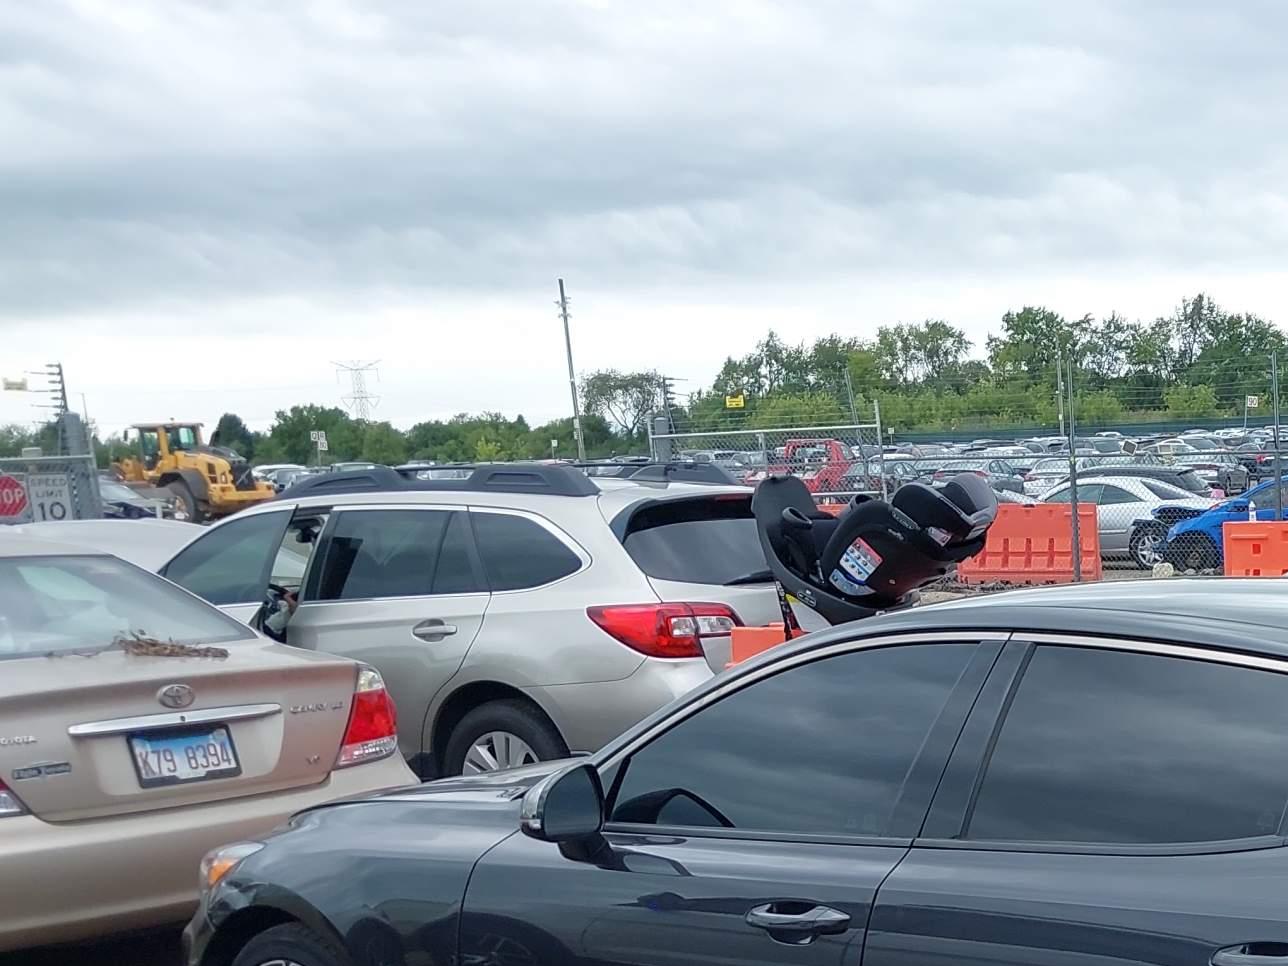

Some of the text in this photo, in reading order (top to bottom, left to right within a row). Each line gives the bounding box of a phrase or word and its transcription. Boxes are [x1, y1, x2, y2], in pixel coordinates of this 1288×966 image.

[1, 488, 25, 504] OP
[38, 501, 66, 521] 10
[139, 743, 233, 776] K79 8394
